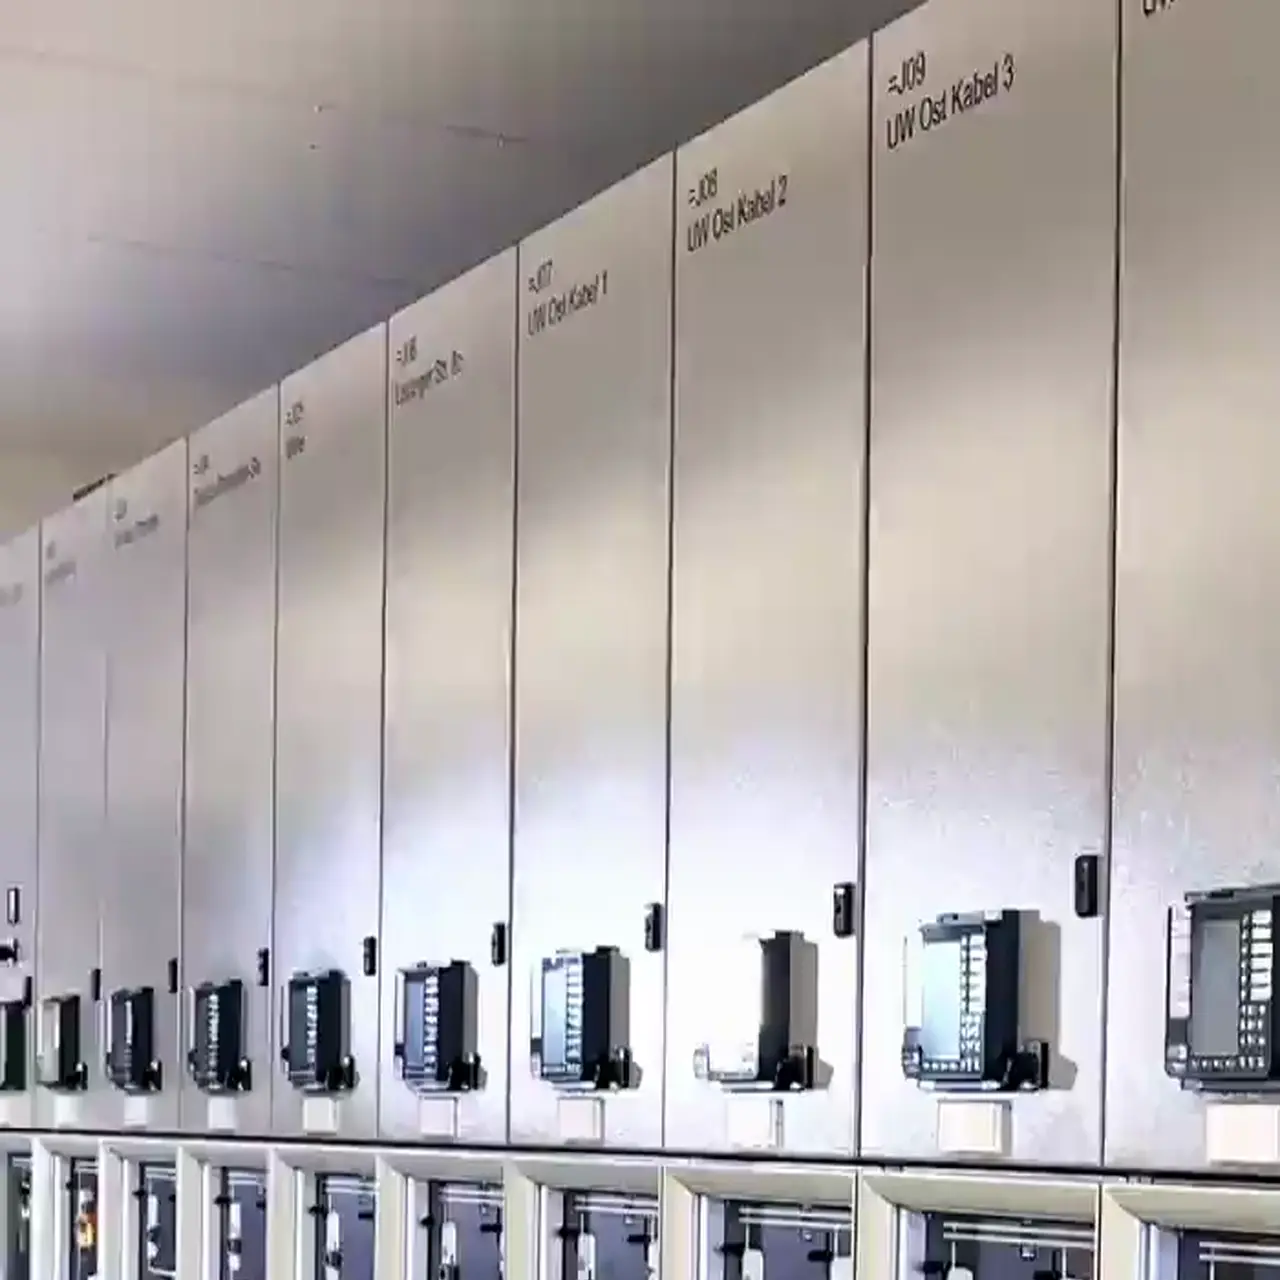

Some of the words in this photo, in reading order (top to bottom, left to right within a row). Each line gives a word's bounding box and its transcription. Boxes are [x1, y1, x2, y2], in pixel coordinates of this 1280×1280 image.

[887, 105, 915, 150] UW
[920, 90, 946, 131] Ost
[952, 62, 998, 115] Kabel
[1003, 53, 1014, 92] 3
